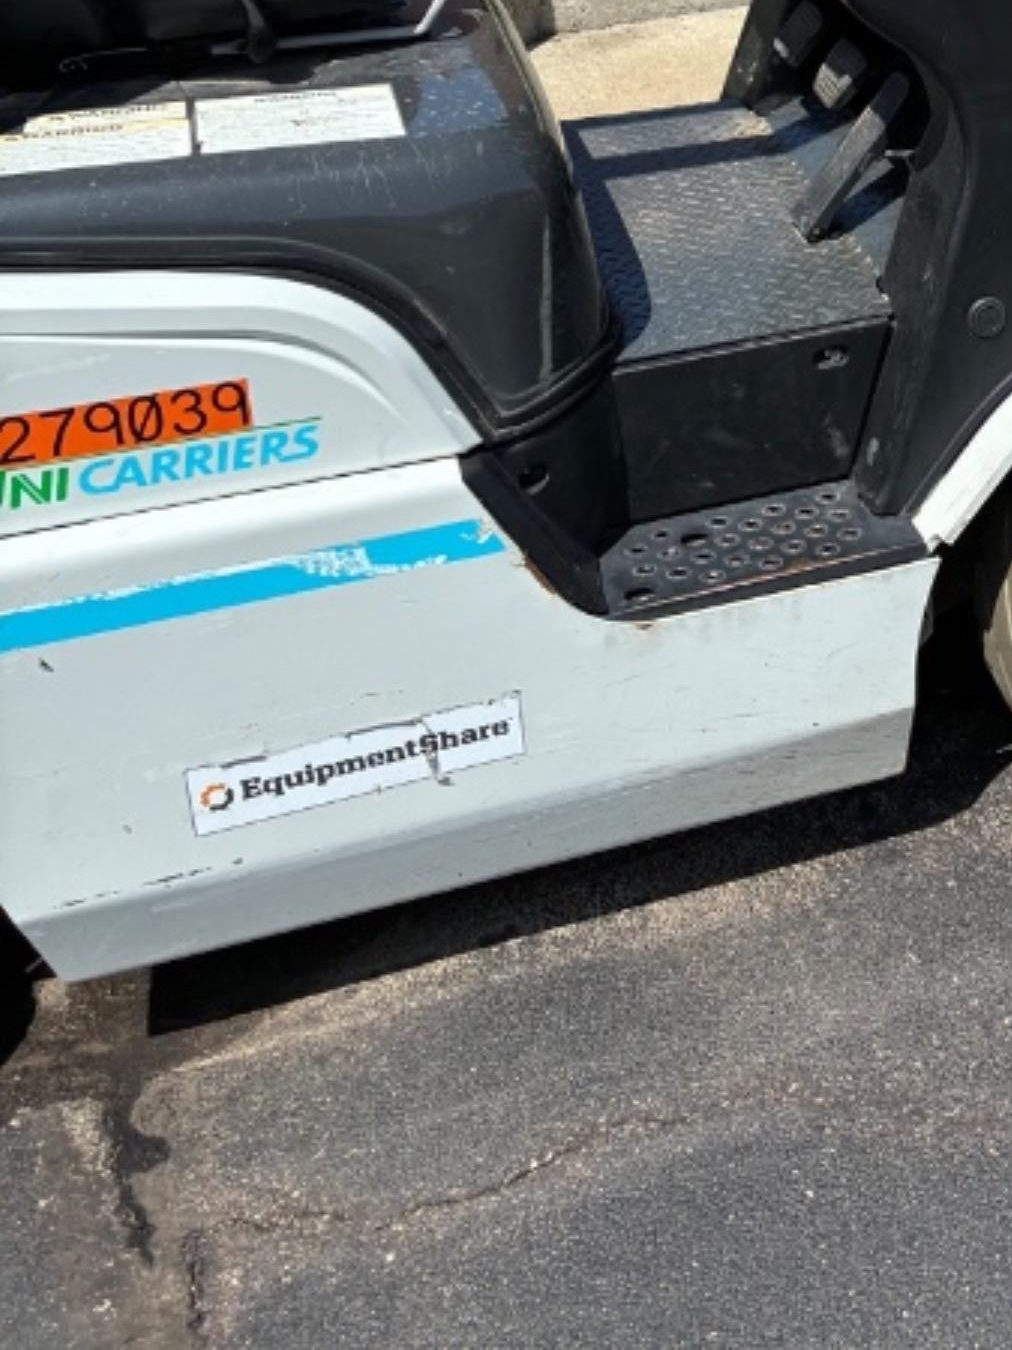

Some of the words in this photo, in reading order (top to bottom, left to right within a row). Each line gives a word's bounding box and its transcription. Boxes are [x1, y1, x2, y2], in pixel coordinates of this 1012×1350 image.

[0, 381, 251, 465] 279039
[0, 466, 69, 510] NI
[240, 718, 510, 803] EquipmentShare
